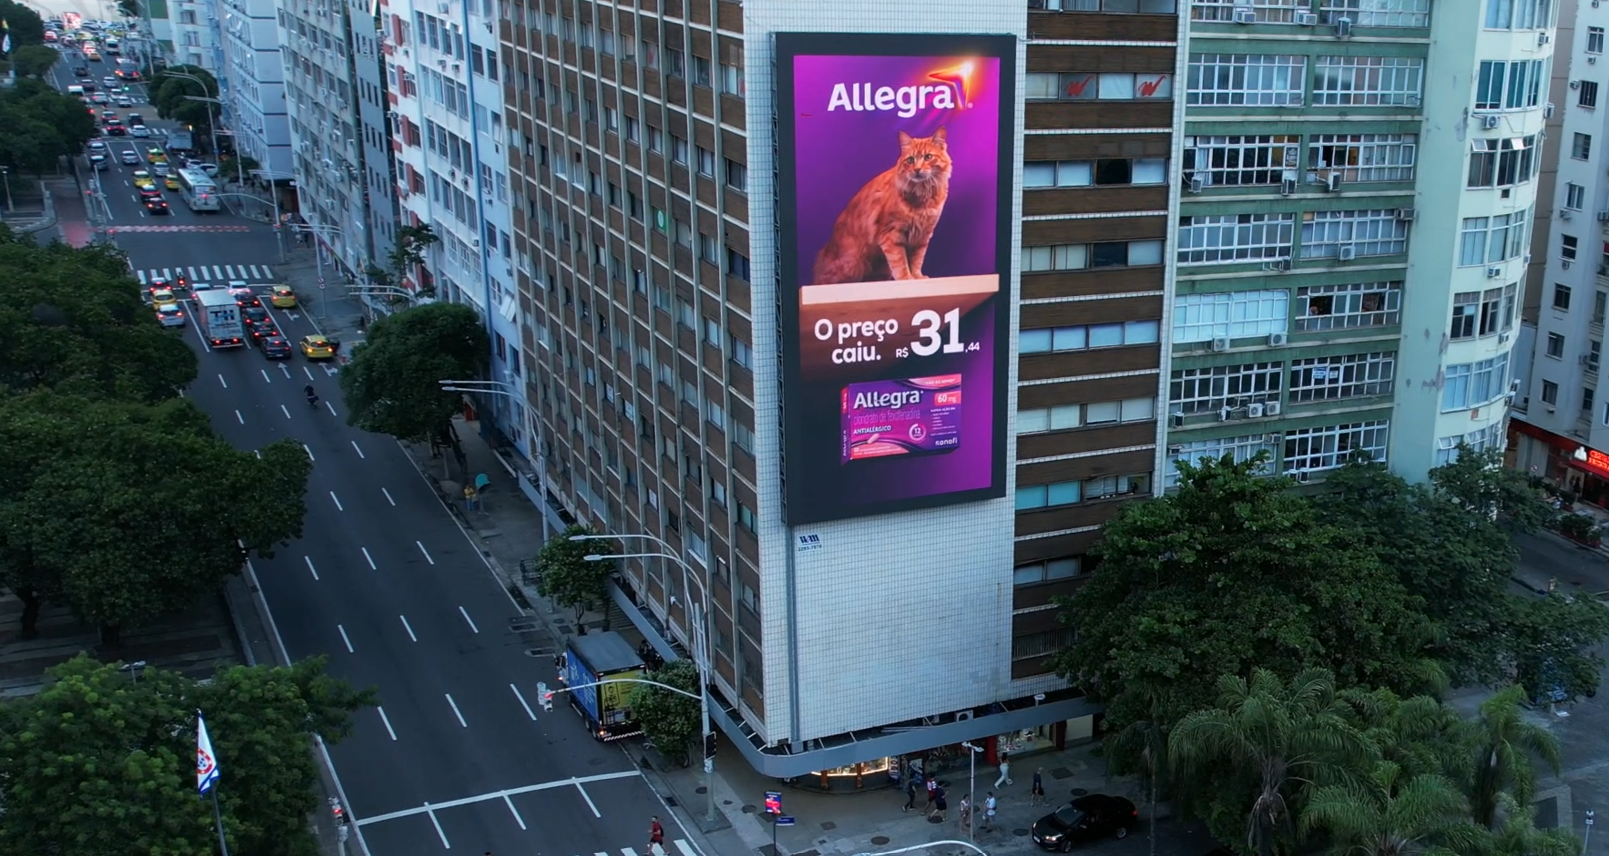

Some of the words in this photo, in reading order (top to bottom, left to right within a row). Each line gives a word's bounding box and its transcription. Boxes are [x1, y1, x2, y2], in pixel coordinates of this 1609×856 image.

[827, 82, 954, 118] Allegra
[814, 319, 833, 341] O
[838, 318, 899, 344] preço
[832, 342, 882, 364] caiu.
[895, 347, 909, 358] R$
[853, 390, 920, 409] Allegra
[937, 393, 948, 403] 60
[935, 437, 958, 446] sanofi
